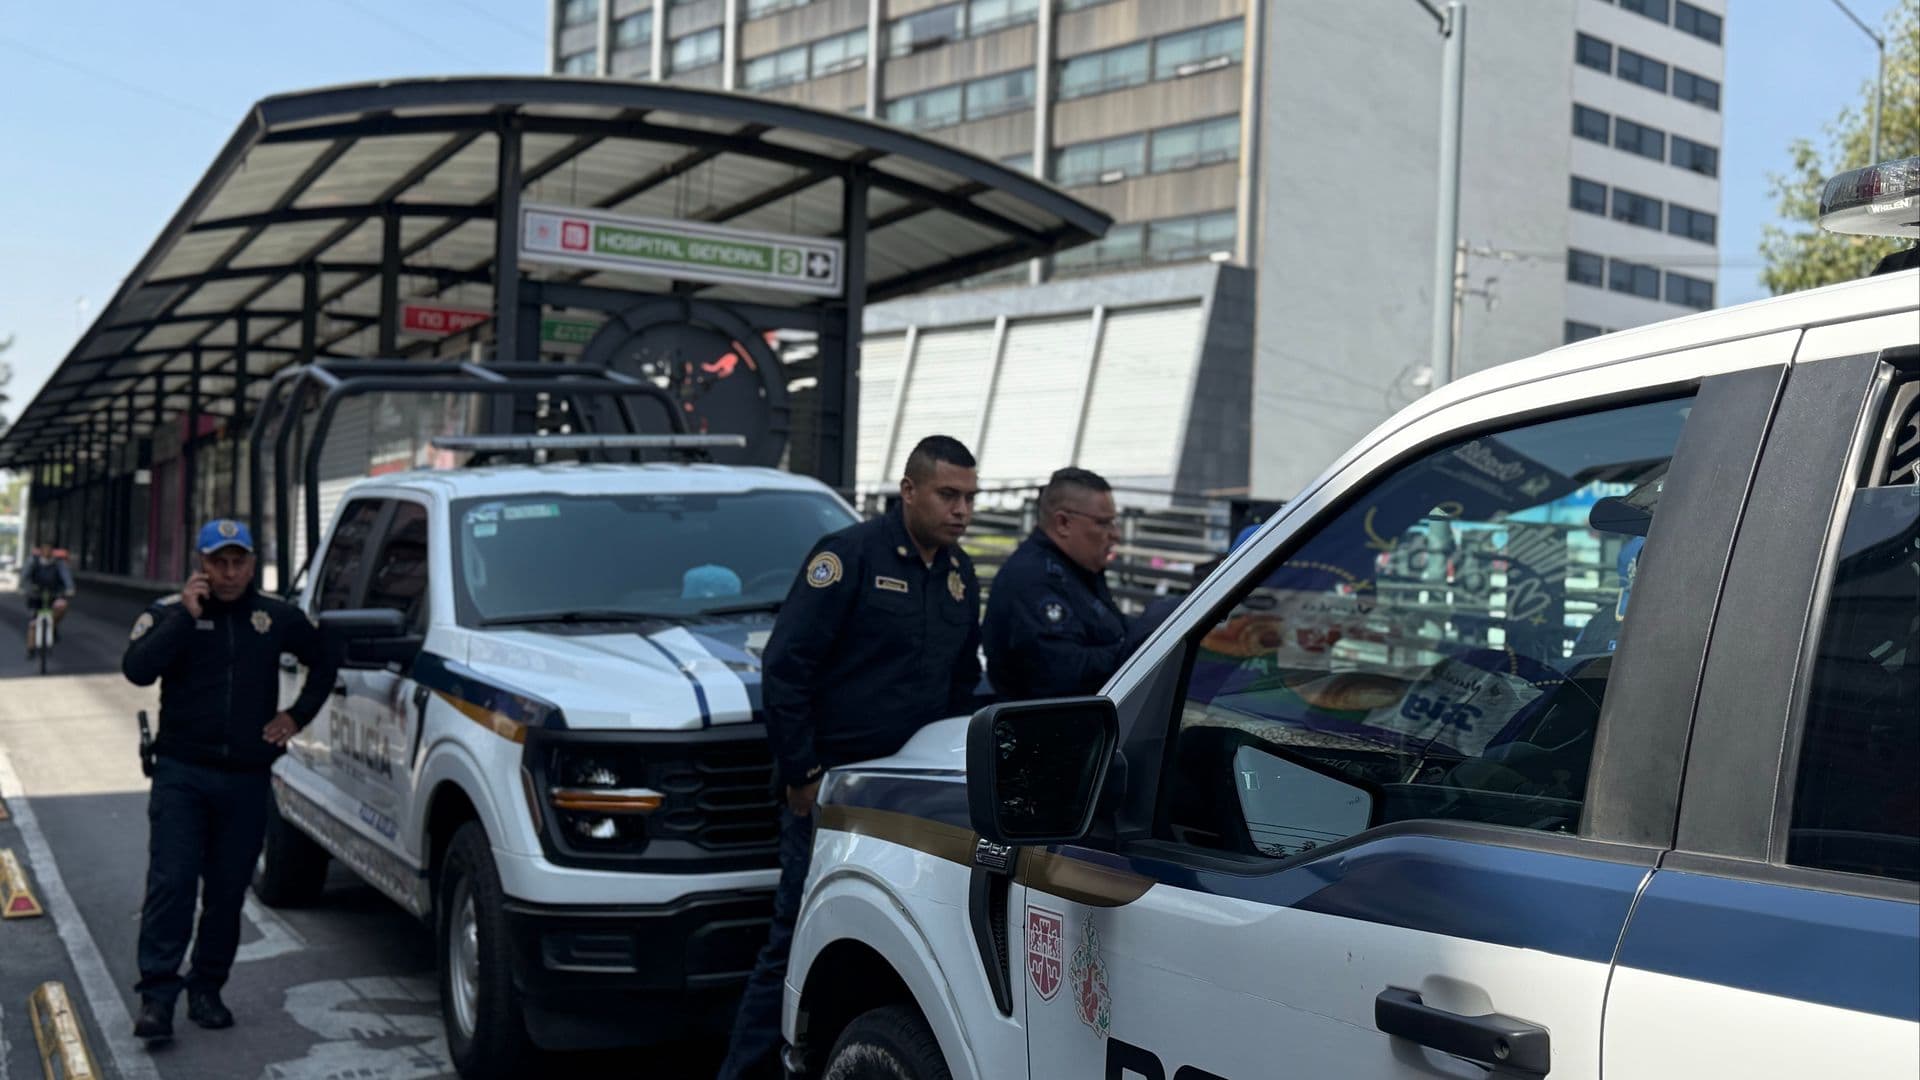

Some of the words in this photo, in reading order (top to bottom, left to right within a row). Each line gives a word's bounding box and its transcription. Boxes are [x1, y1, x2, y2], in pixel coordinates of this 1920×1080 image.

[600, 231, 682, 258] HOSPITAL
[688, 242, 767, 268] GENERAL
[782, 251, 799, 273] 3
